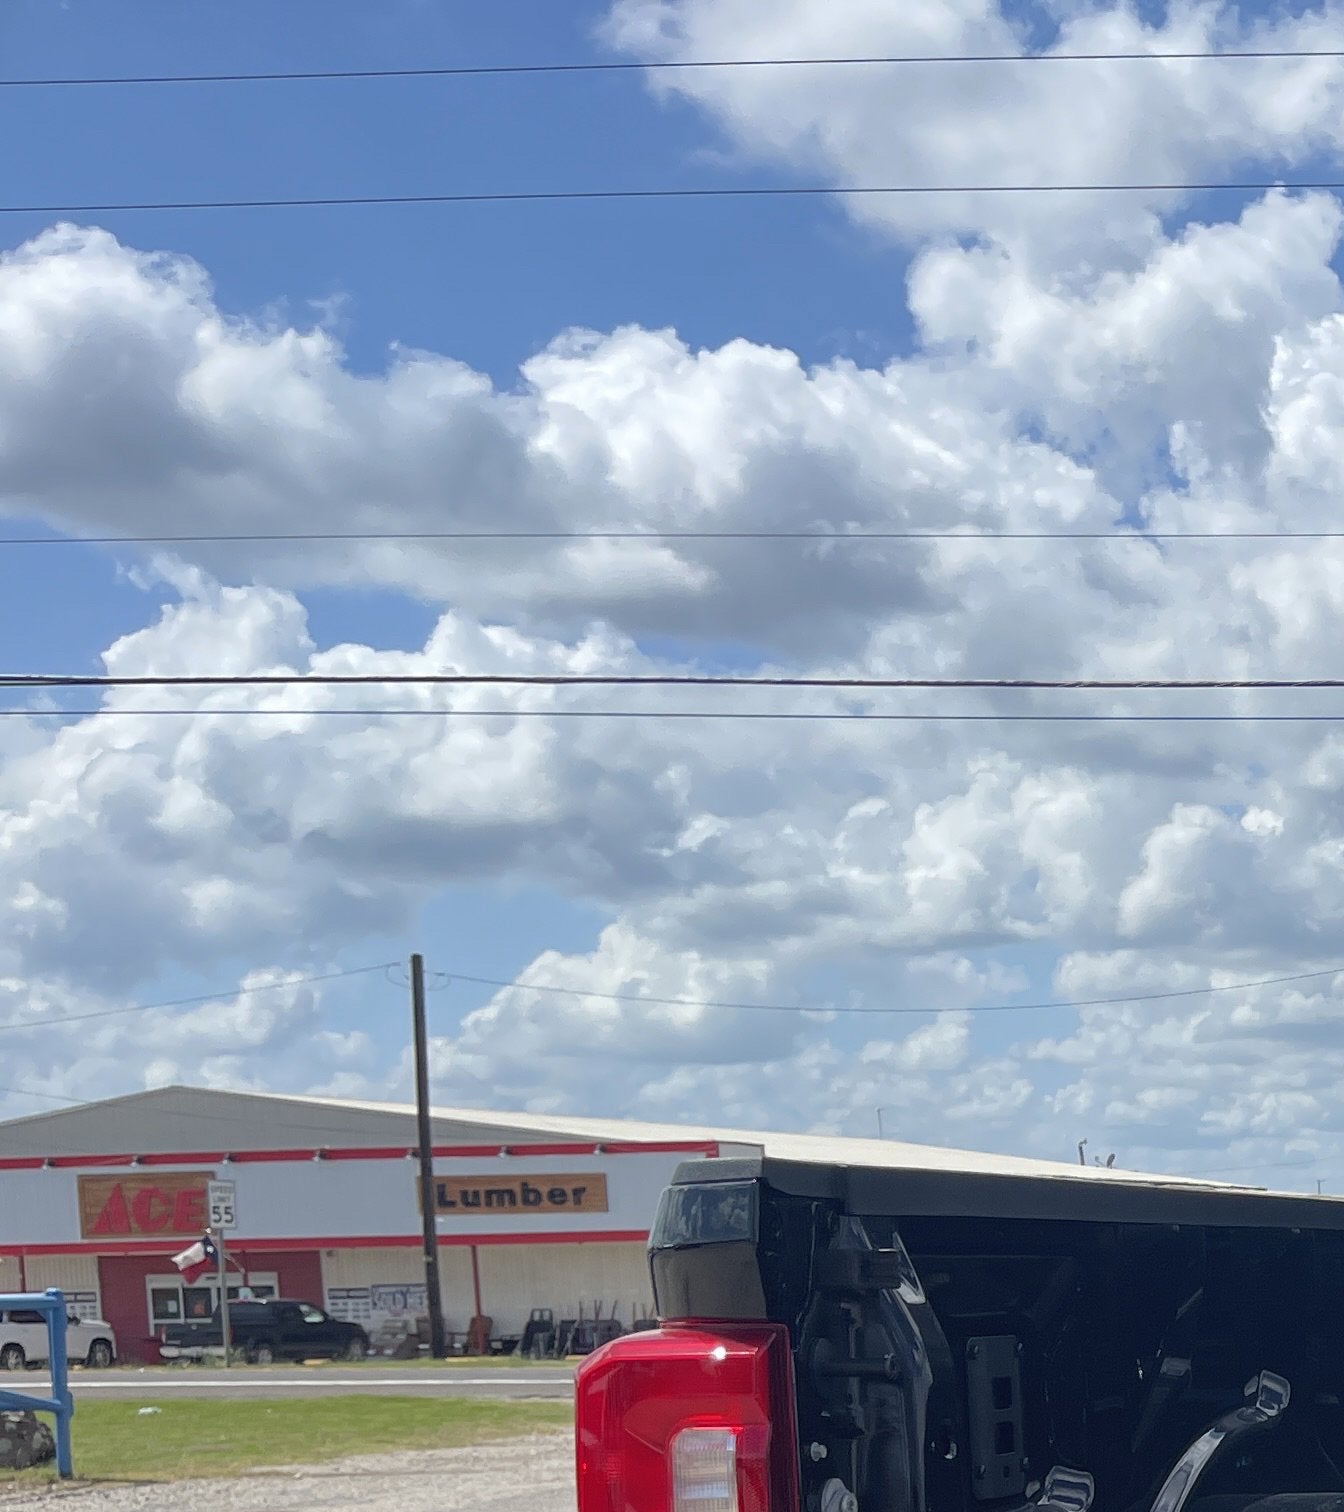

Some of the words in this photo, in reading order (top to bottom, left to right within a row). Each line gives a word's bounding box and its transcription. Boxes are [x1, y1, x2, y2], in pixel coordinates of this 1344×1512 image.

[90, 1182, 208, 1233] ACE
[436, 1181, 587, 1209] Lumber
[212, 1205, 234, 1225] 55
